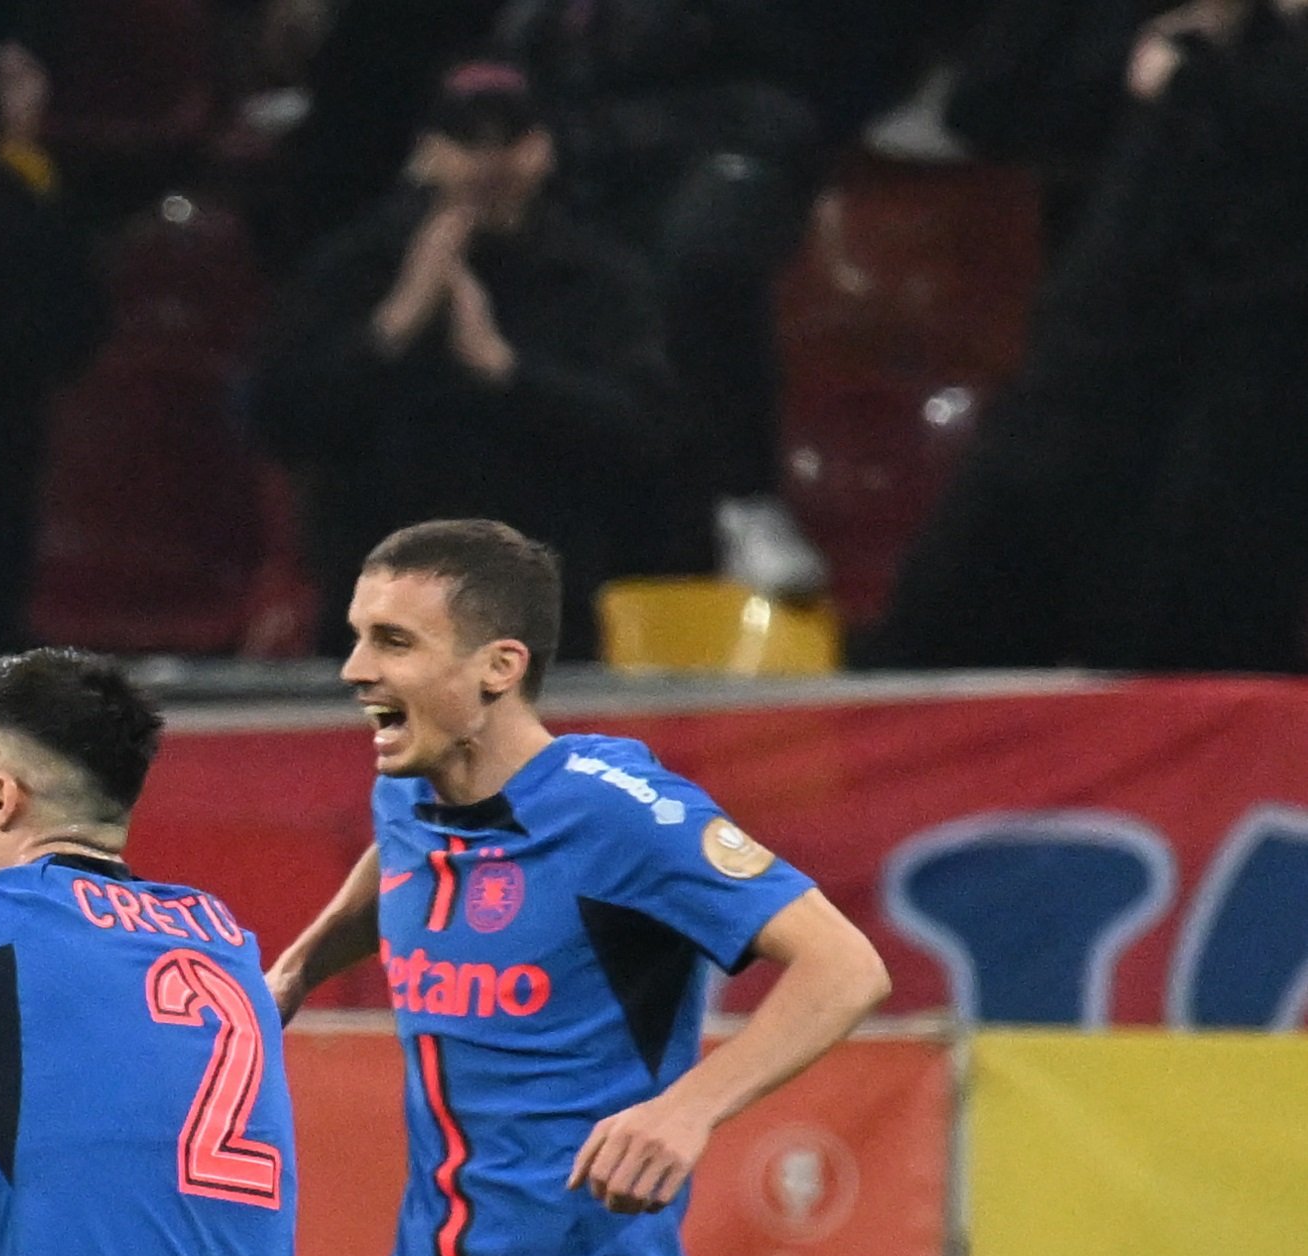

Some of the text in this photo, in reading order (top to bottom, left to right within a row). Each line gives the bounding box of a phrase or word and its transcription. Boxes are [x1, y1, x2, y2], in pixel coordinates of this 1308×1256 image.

[72, 878, 245, 947] CRETU
[380, 936, 552, 1019] etano
[145, 948, 281, 1210] 2
